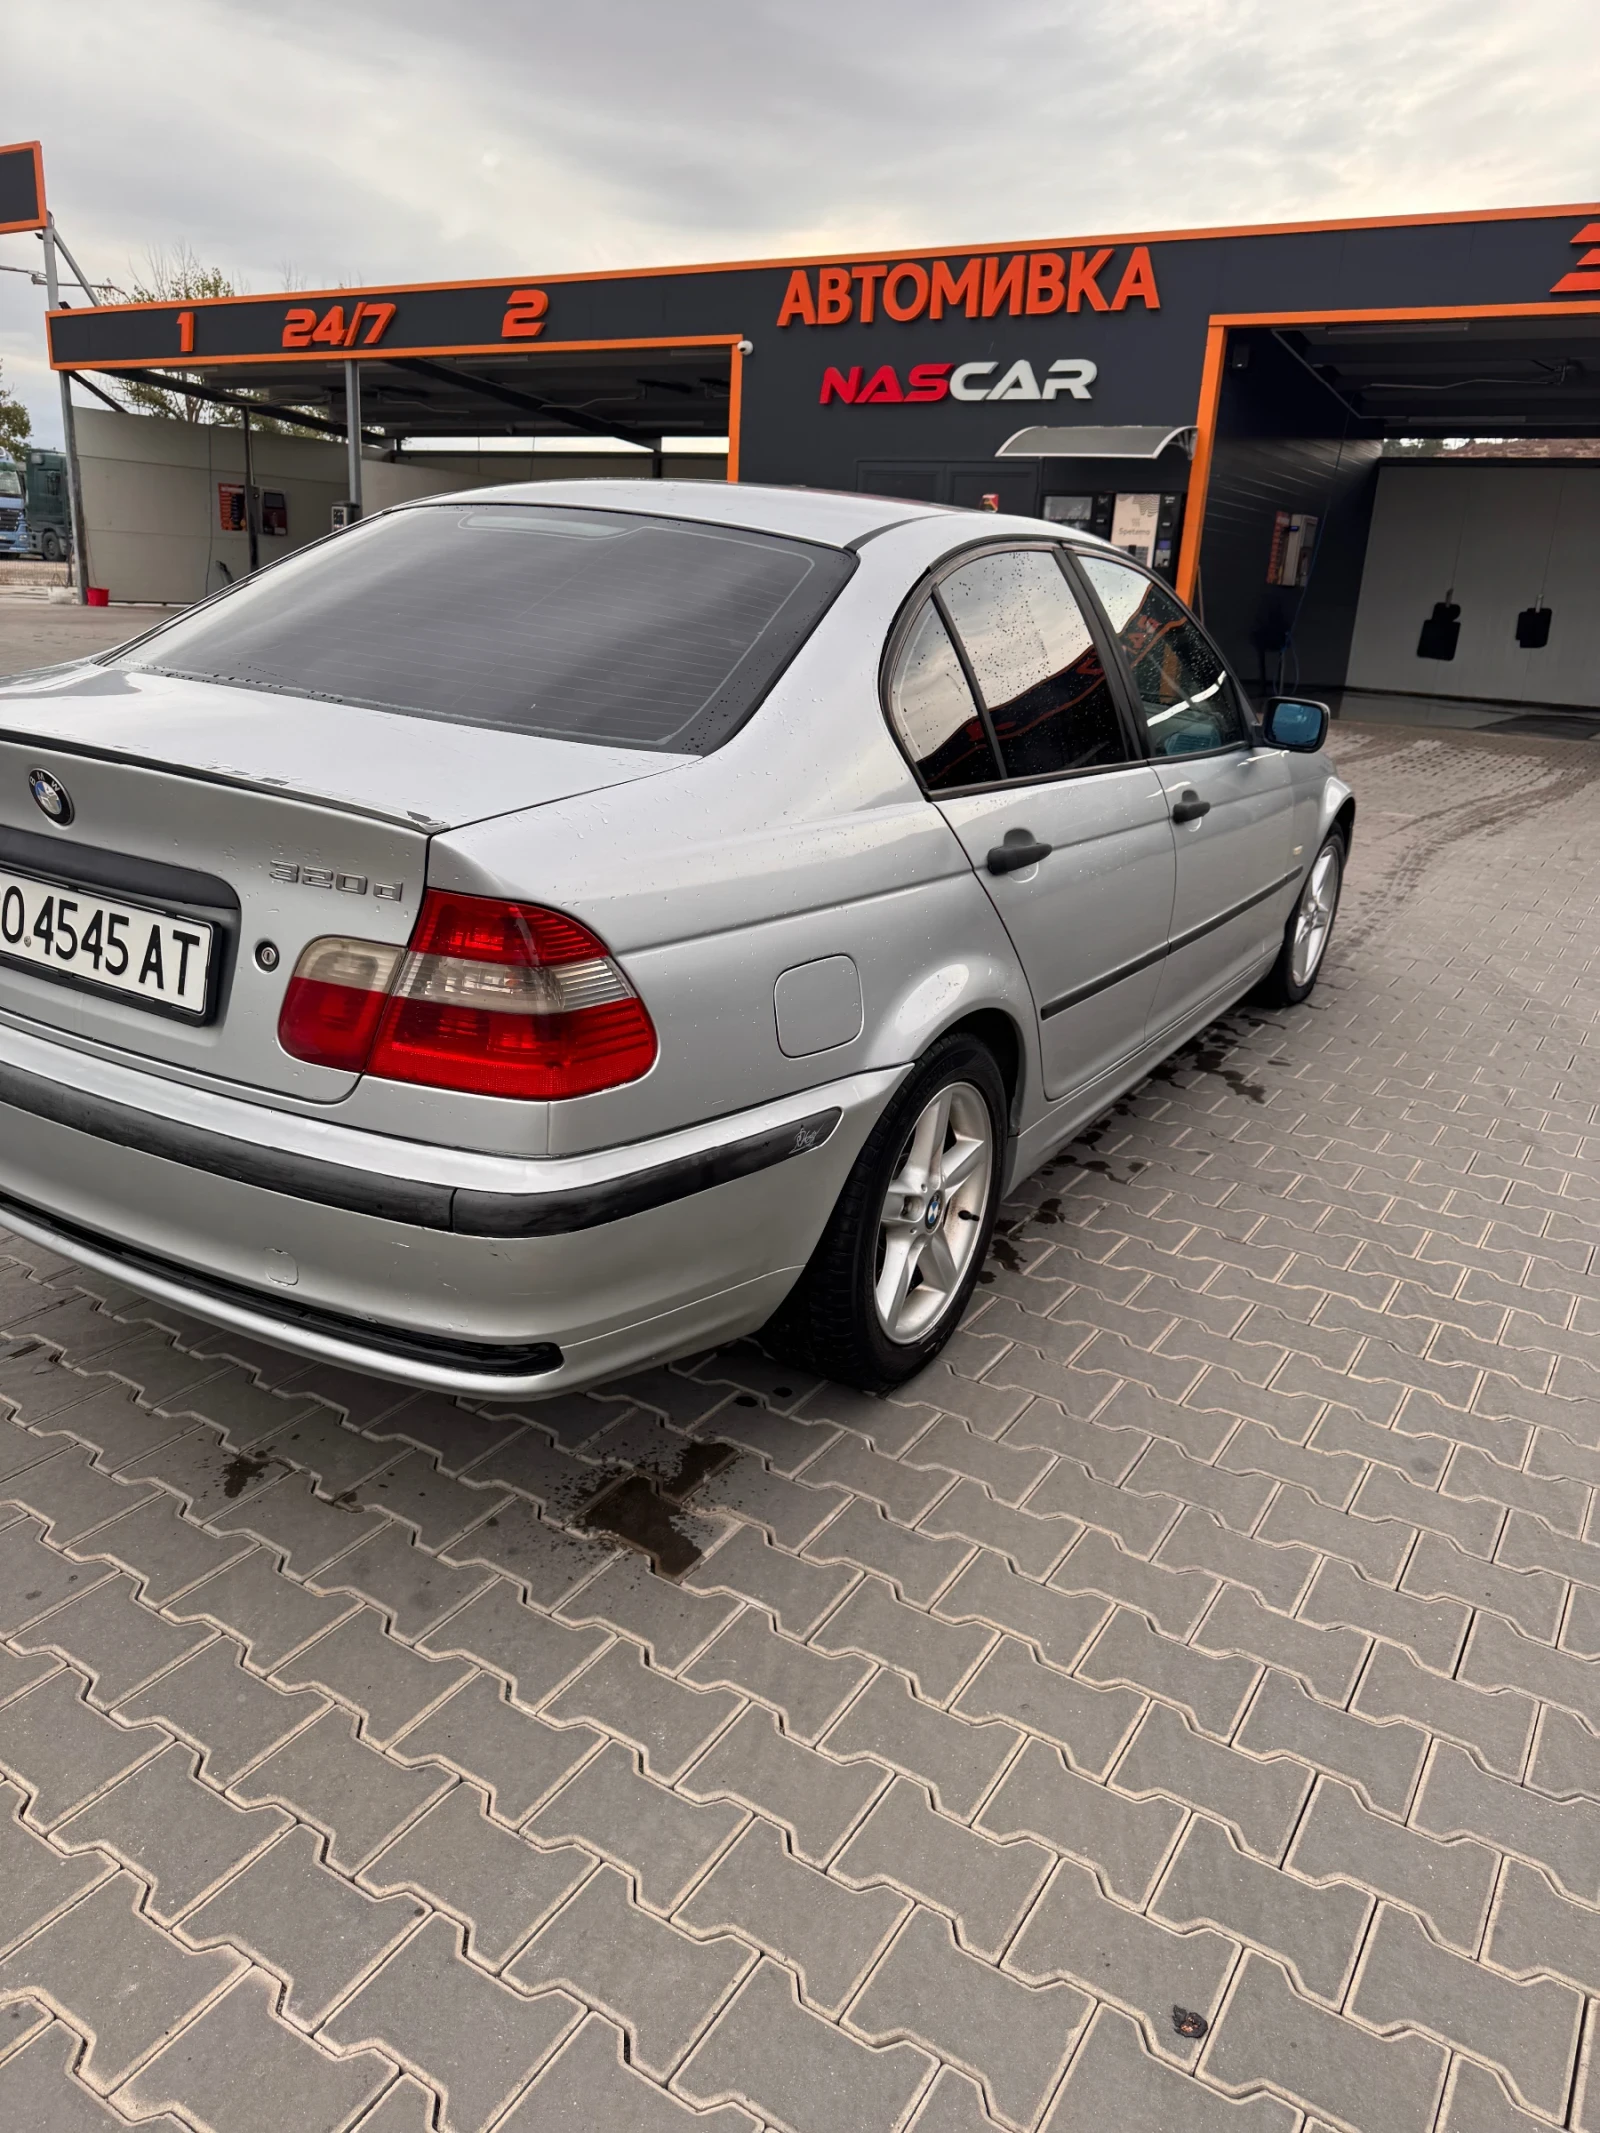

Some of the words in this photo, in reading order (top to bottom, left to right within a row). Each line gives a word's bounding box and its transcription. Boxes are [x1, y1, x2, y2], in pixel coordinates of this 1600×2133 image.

[777, 246, 1160, 326] АВТОМИВКА
[176, 312, 194, 352] 1
[282, 302, 396, 347] 24/7
[502, 289, 548, 337] 2
[819, 359, 1098, 403] NASCAR
[30, 771, 61, 792] BMW
[268, 859, 403, 901] 320d
[33, 896, 130, 976] 4545
[138, 924, 201, 996] AT
